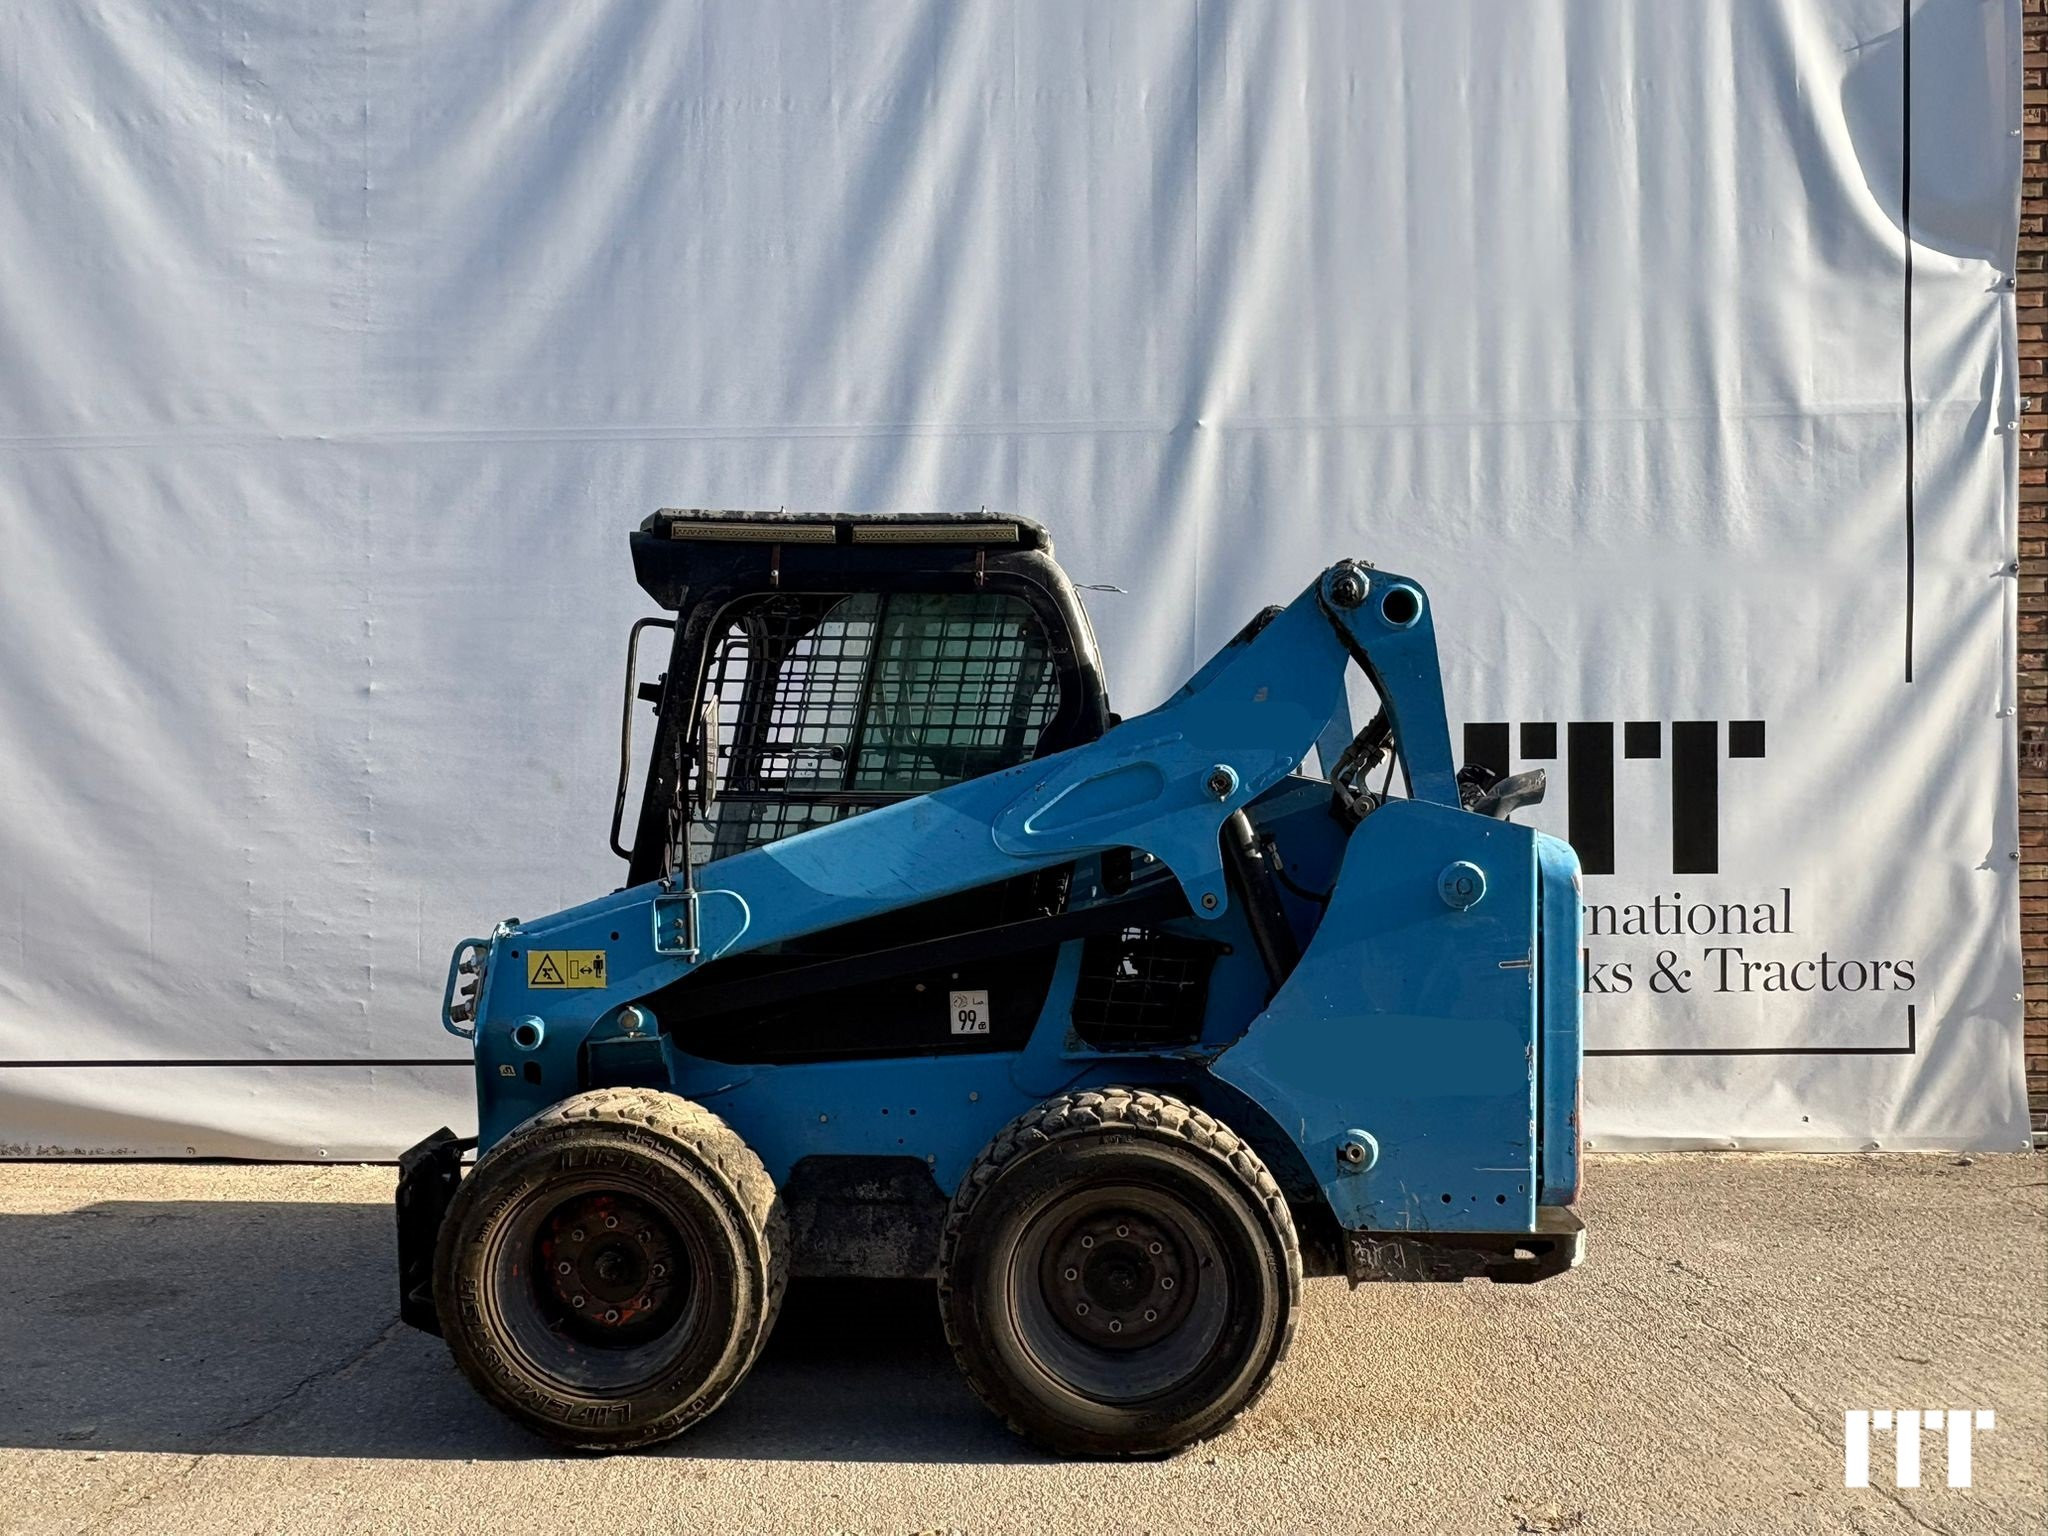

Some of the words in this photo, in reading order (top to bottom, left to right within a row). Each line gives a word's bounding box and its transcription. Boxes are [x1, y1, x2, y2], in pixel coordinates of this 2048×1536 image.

[1583, 889, 1793, 936] national
[1649, 950, 1692, 994] &
[1704, 947, 1917, 994] Tractors
[958, 1009, 977, 1031] 99
